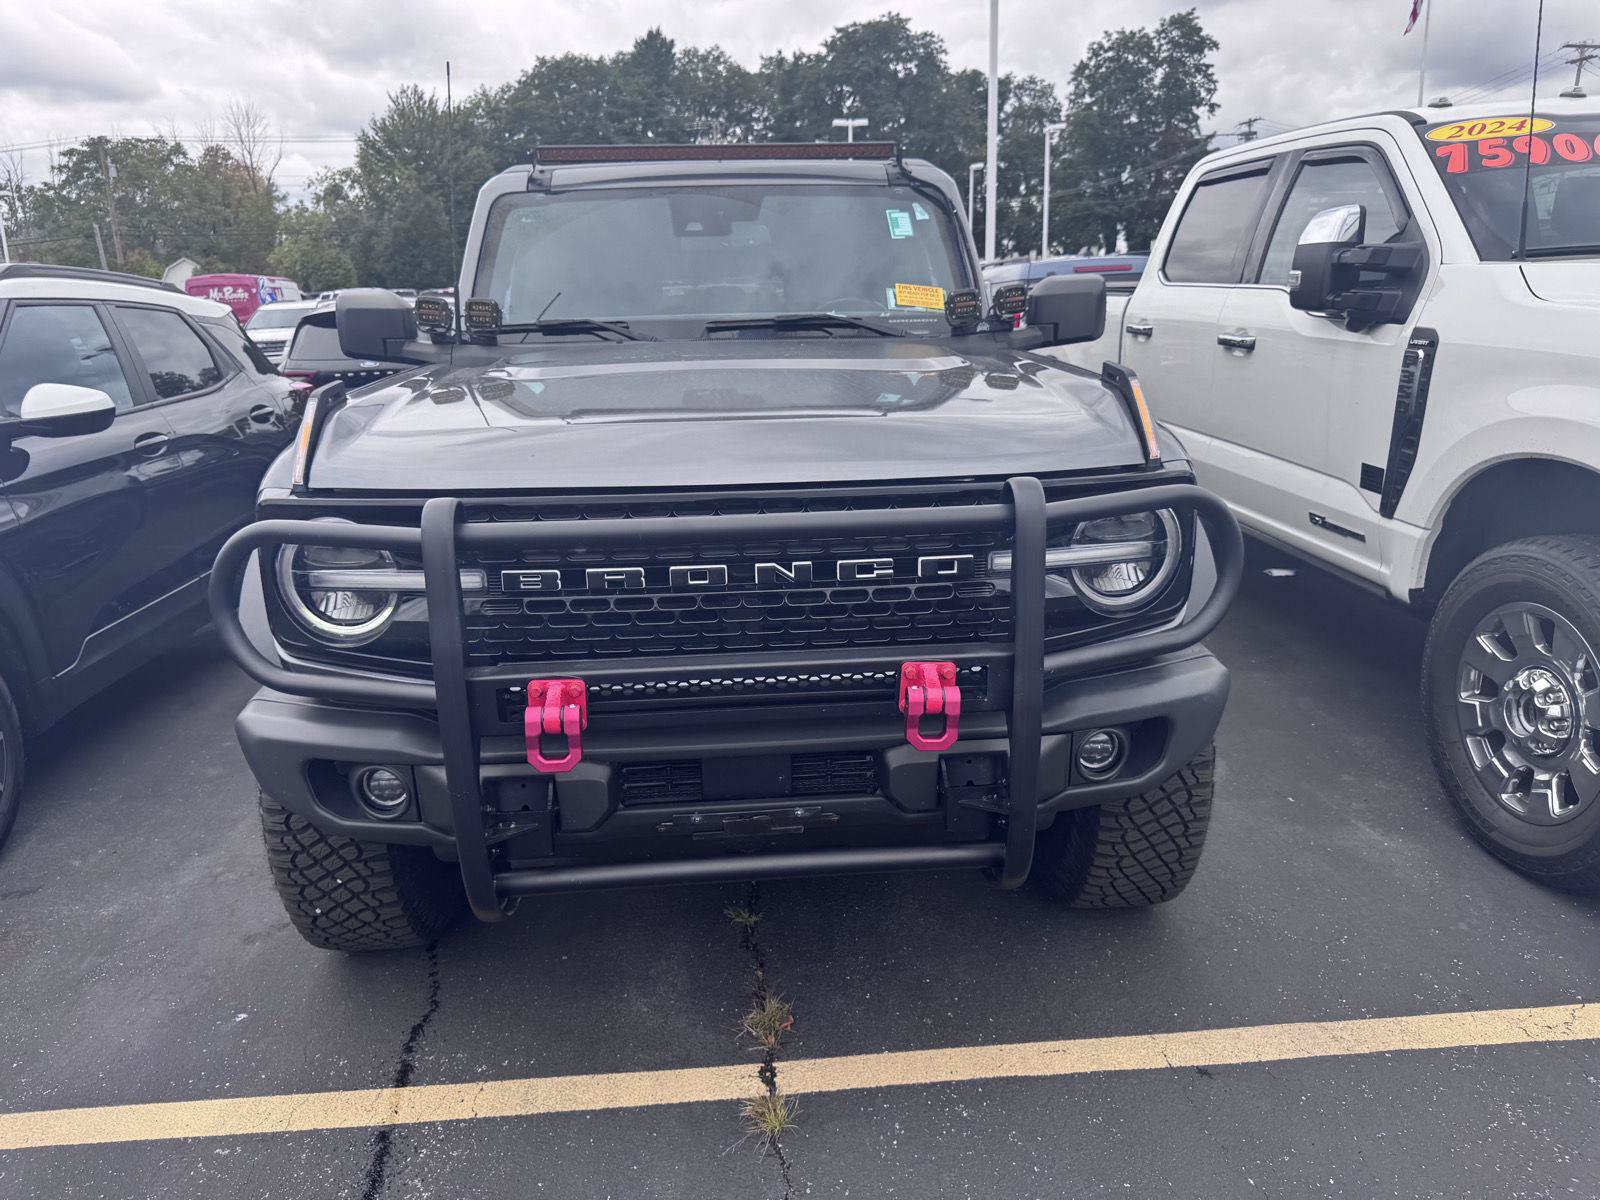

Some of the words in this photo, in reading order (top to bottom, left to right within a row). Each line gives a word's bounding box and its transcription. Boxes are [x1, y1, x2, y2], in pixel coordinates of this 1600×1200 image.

[1447, 118, 1529, 140] 2024
[1435, 132, 1600, 174] 7590
[500, 554, 975, 592] BRONCO
